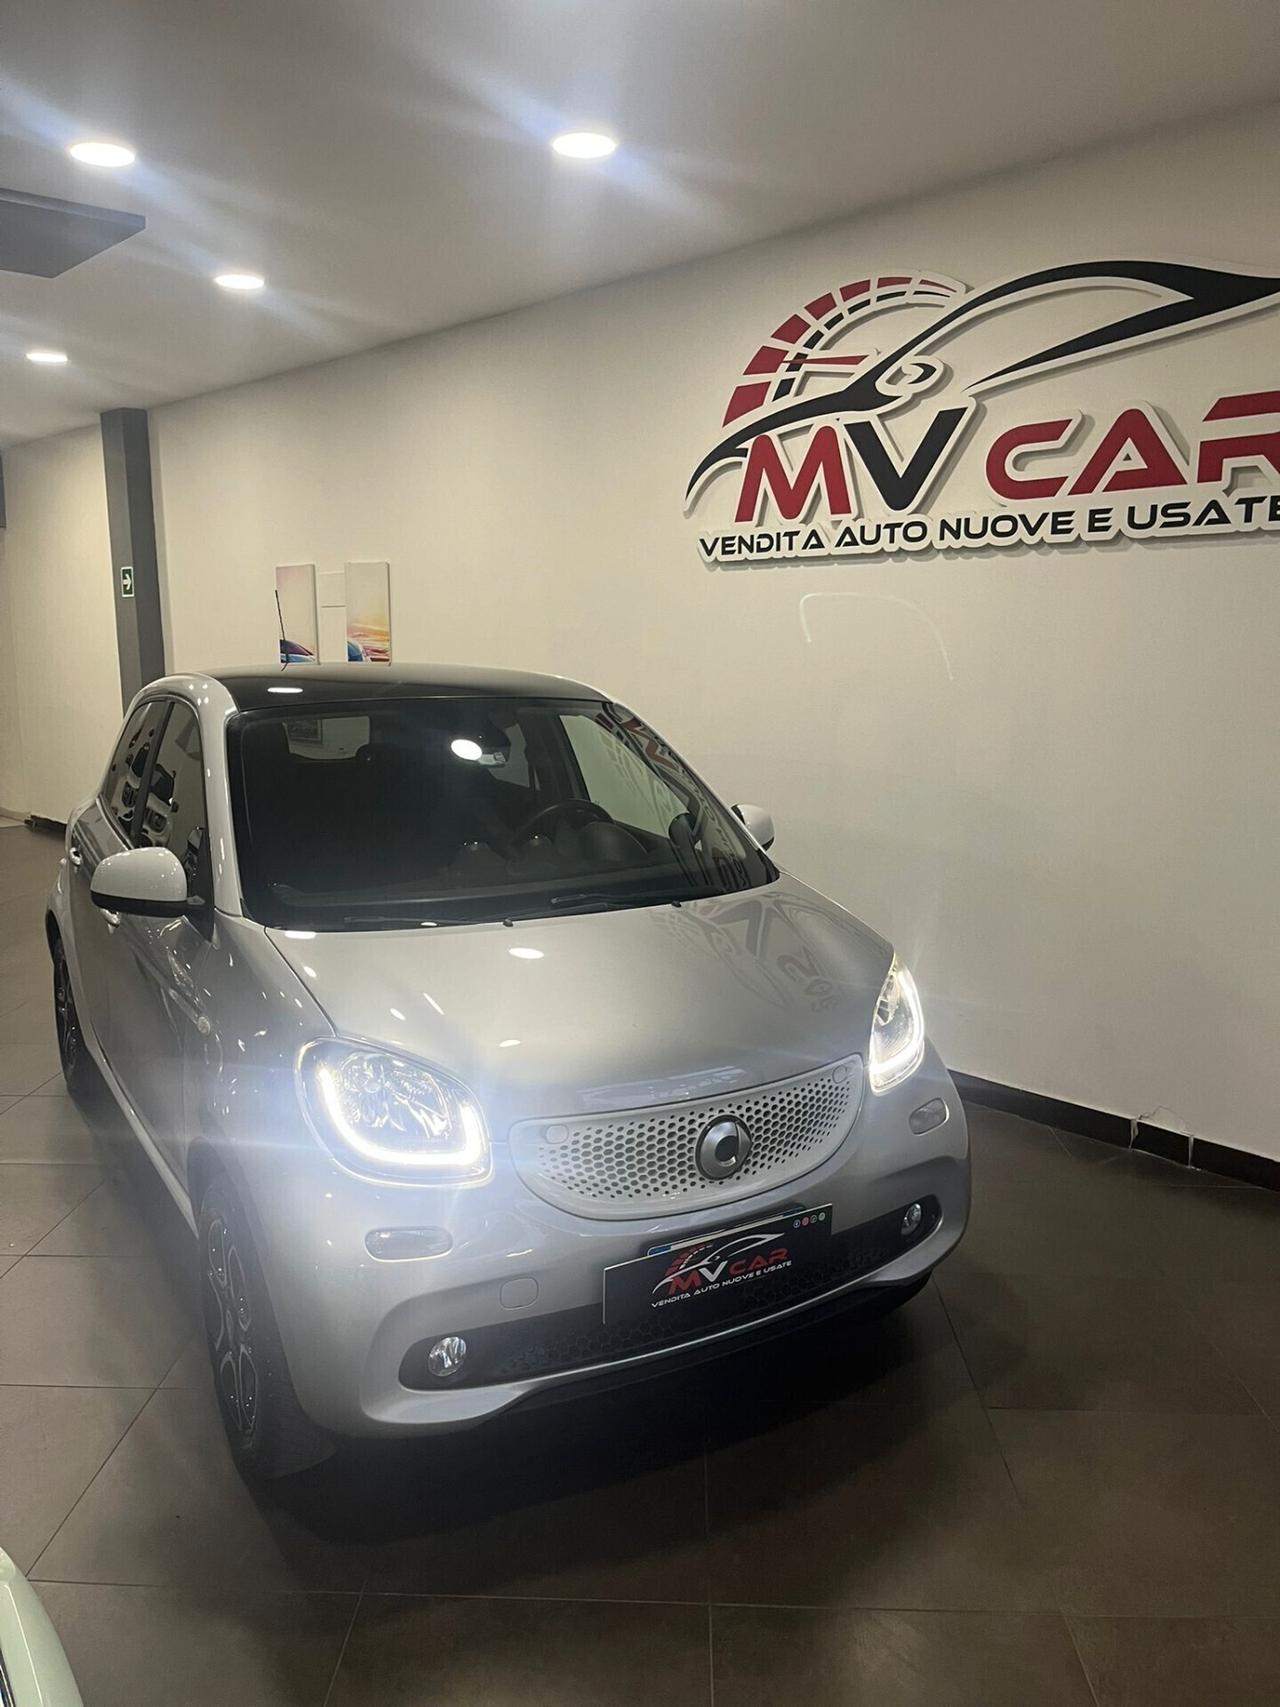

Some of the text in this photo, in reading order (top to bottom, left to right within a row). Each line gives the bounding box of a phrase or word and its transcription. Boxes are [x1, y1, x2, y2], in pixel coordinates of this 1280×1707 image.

[734, 390, 1280, 523] MV CAR
[699, 527, 826, 557] VENDITA
[834, 520, 928, 549] AUTO
[938, 510, 1075, 541] NUOVE
[1086, 507, 1115, 533] E
[651, 1260, 792, 1308] VENDITA AUTO NUOVE E USATE
[668, 1247, 790, 1295] MV CAR
